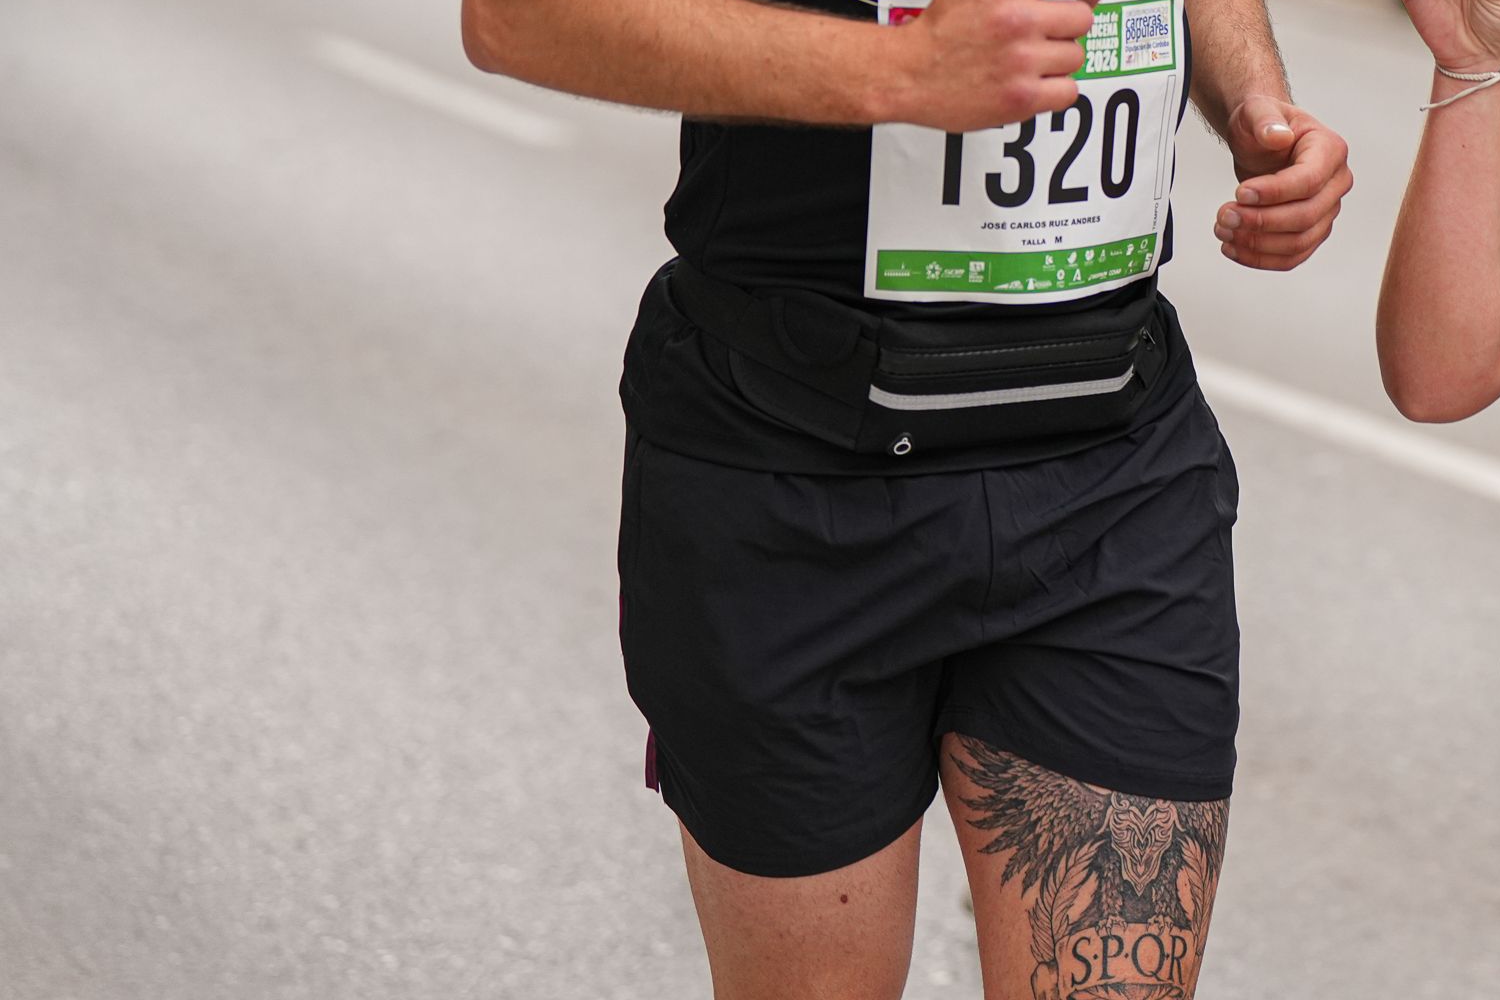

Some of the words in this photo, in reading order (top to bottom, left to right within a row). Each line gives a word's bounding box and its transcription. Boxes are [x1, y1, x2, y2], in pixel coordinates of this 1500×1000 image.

[1125, 13, 1162, 28] carreras
[1125, 23, 1169, 44] populares
[1085, 49, 1119, 74] 2026
[941, 87, 1140, 208] 1320
[981, 221, 1007, 230] JOSÉ
[1009, 221, 1047, 230] CARLOS
[1049, 219, 1069, 227] RUIZ
[1071, 215, 1101, 225] ANDRES
[1055, 236, 1062, 244] M
